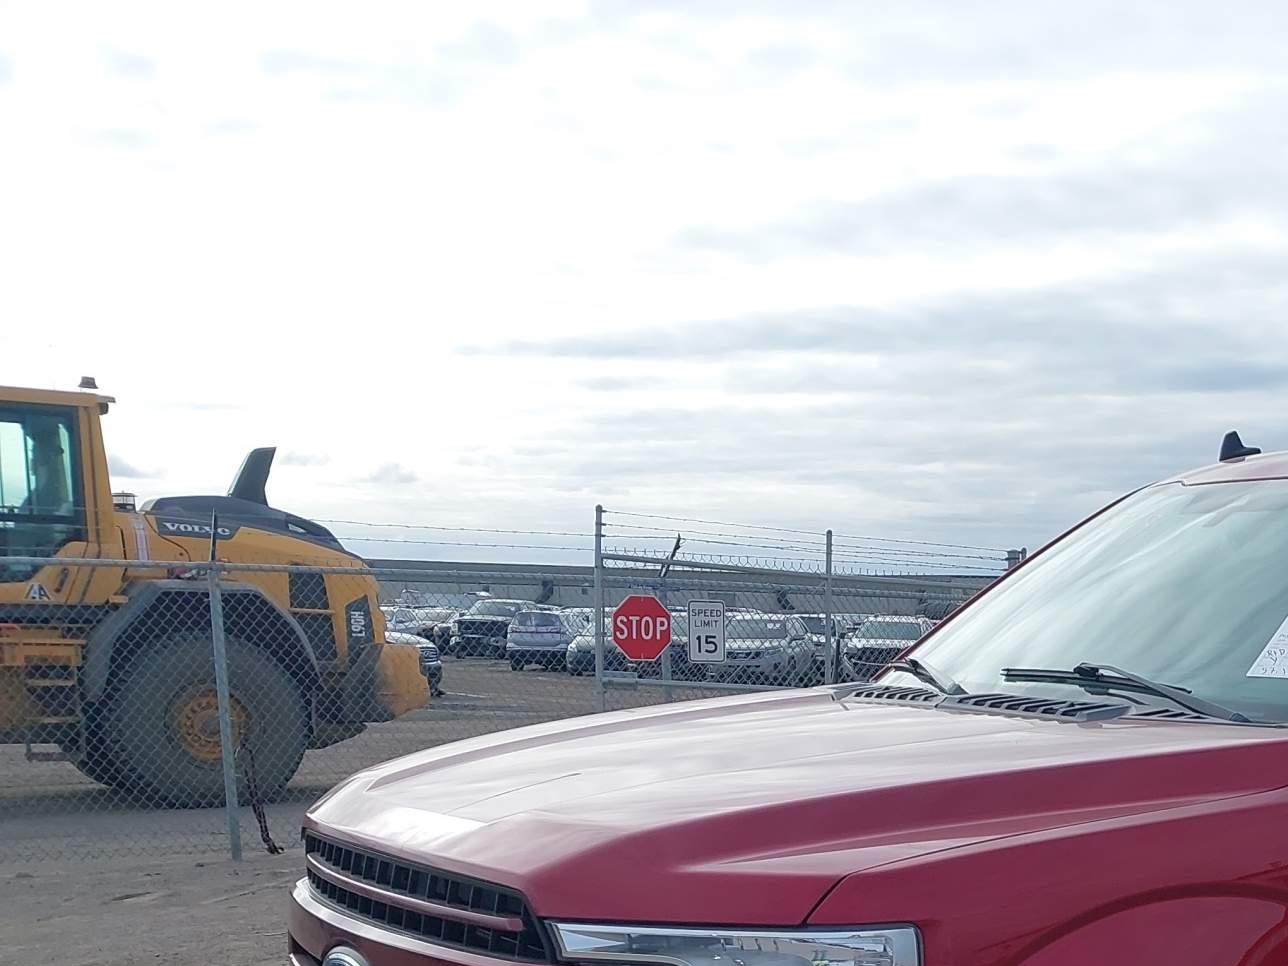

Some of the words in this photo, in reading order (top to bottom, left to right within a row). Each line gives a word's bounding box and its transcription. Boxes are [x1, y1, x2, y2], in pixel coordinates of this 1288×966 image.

[691, 609, 722, 618] SPEED
[350, 611, 366, 637] L90H
[616, 615, 669, 641] STOP
[694, 619, 719, 628] LIMIT
[696, 635, 718, 654] 15
